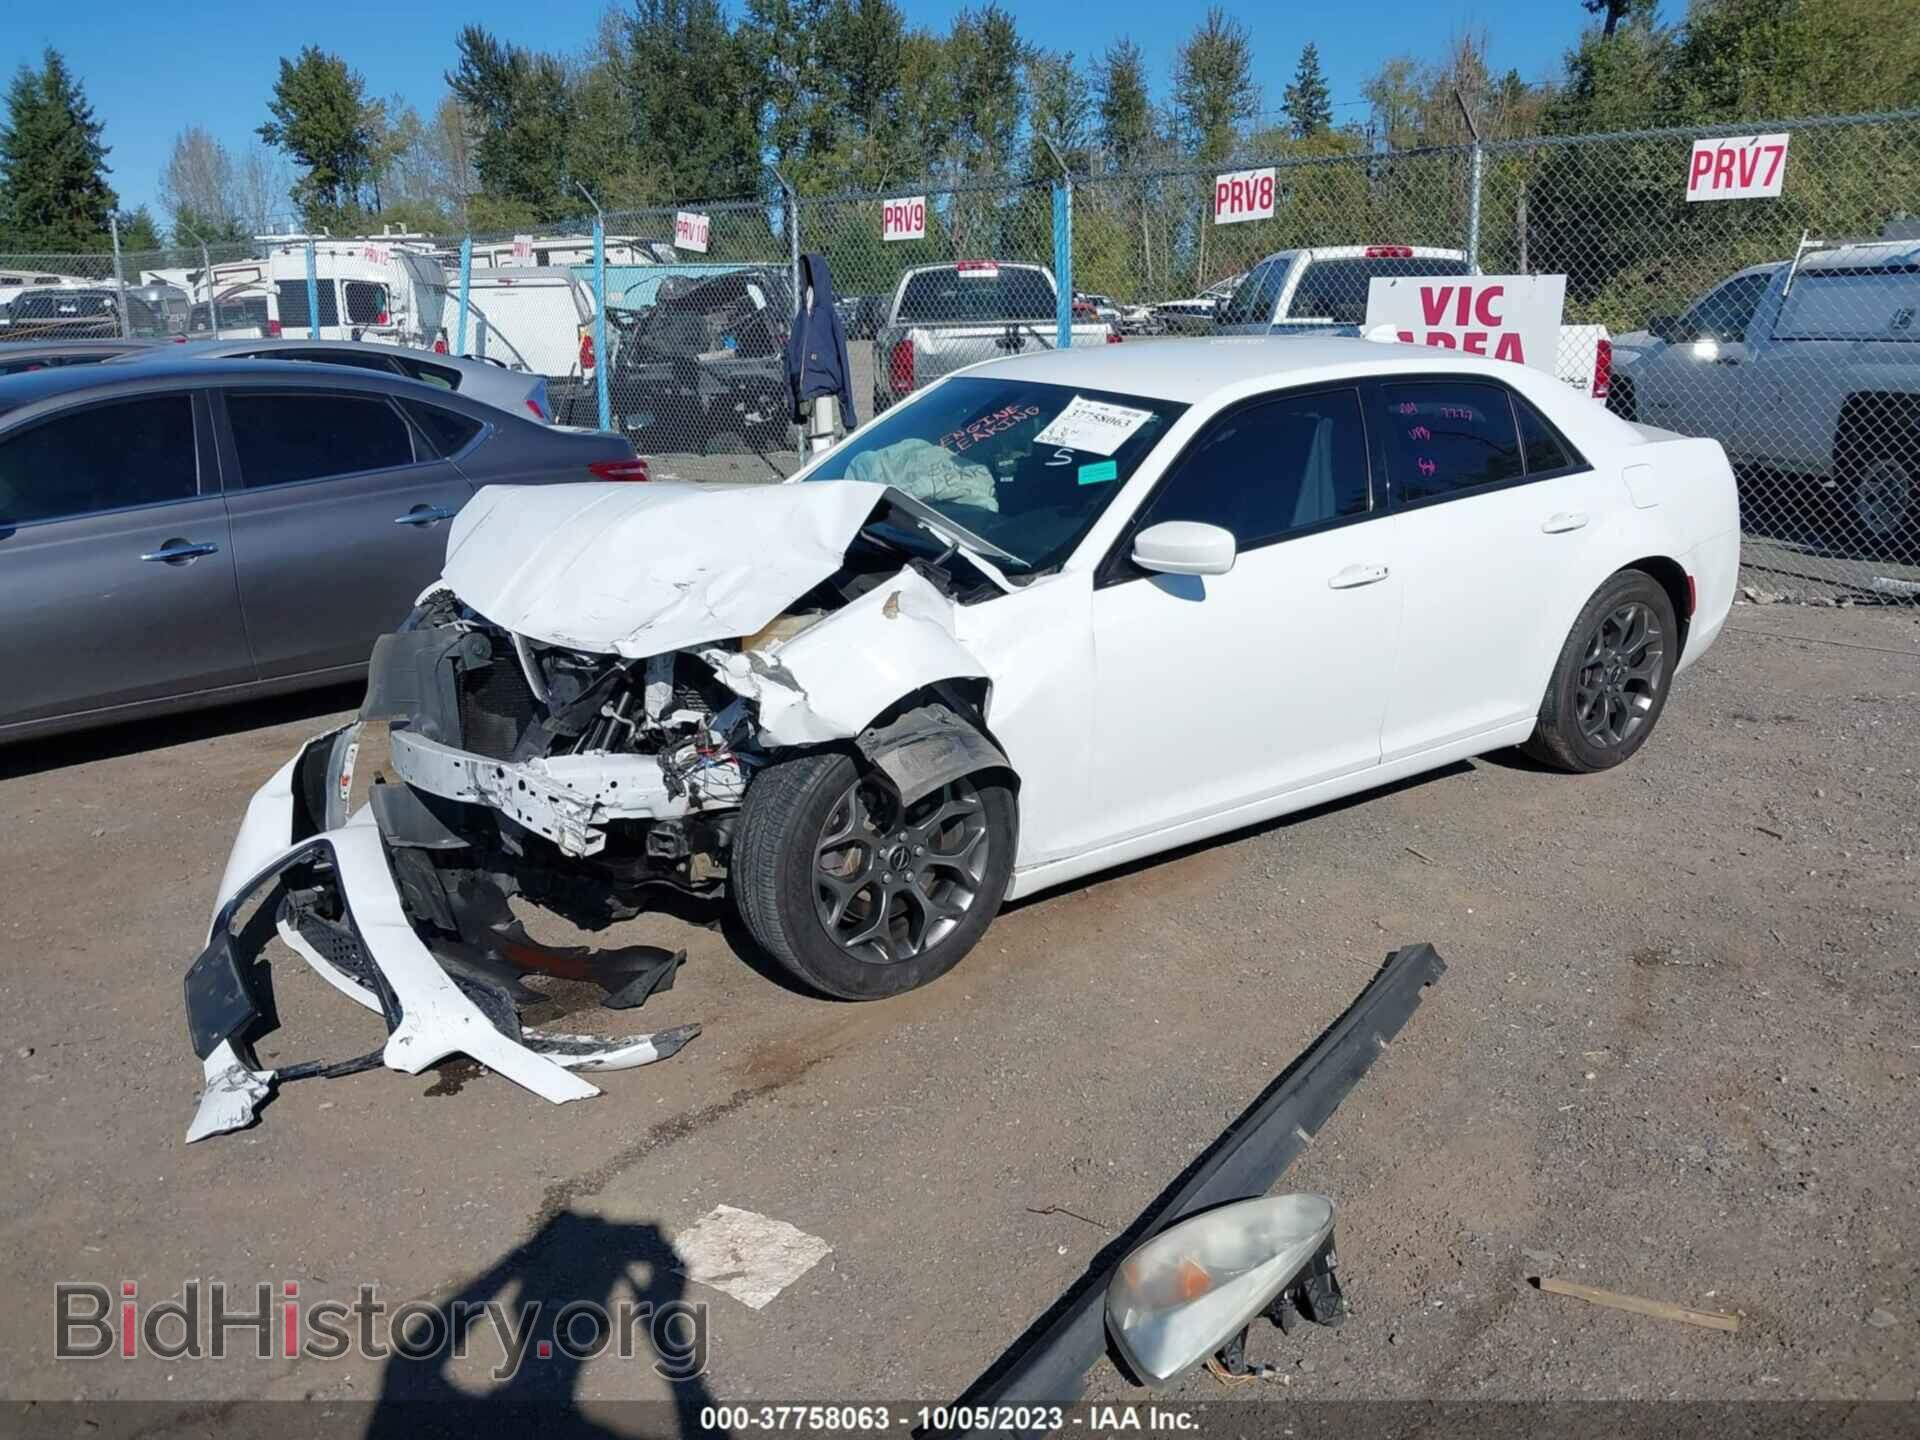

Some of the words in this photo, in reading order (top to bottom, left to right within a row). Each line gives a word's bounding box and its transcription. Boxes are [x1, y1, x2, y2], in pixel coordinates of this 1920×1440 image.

[1690, 145, 1785, 191] PRV7
[1217, 176, 1273, 216] PRV8
[884, 204, 924, 234] PRV9
[1420, 285, 1505, 327] VIC
